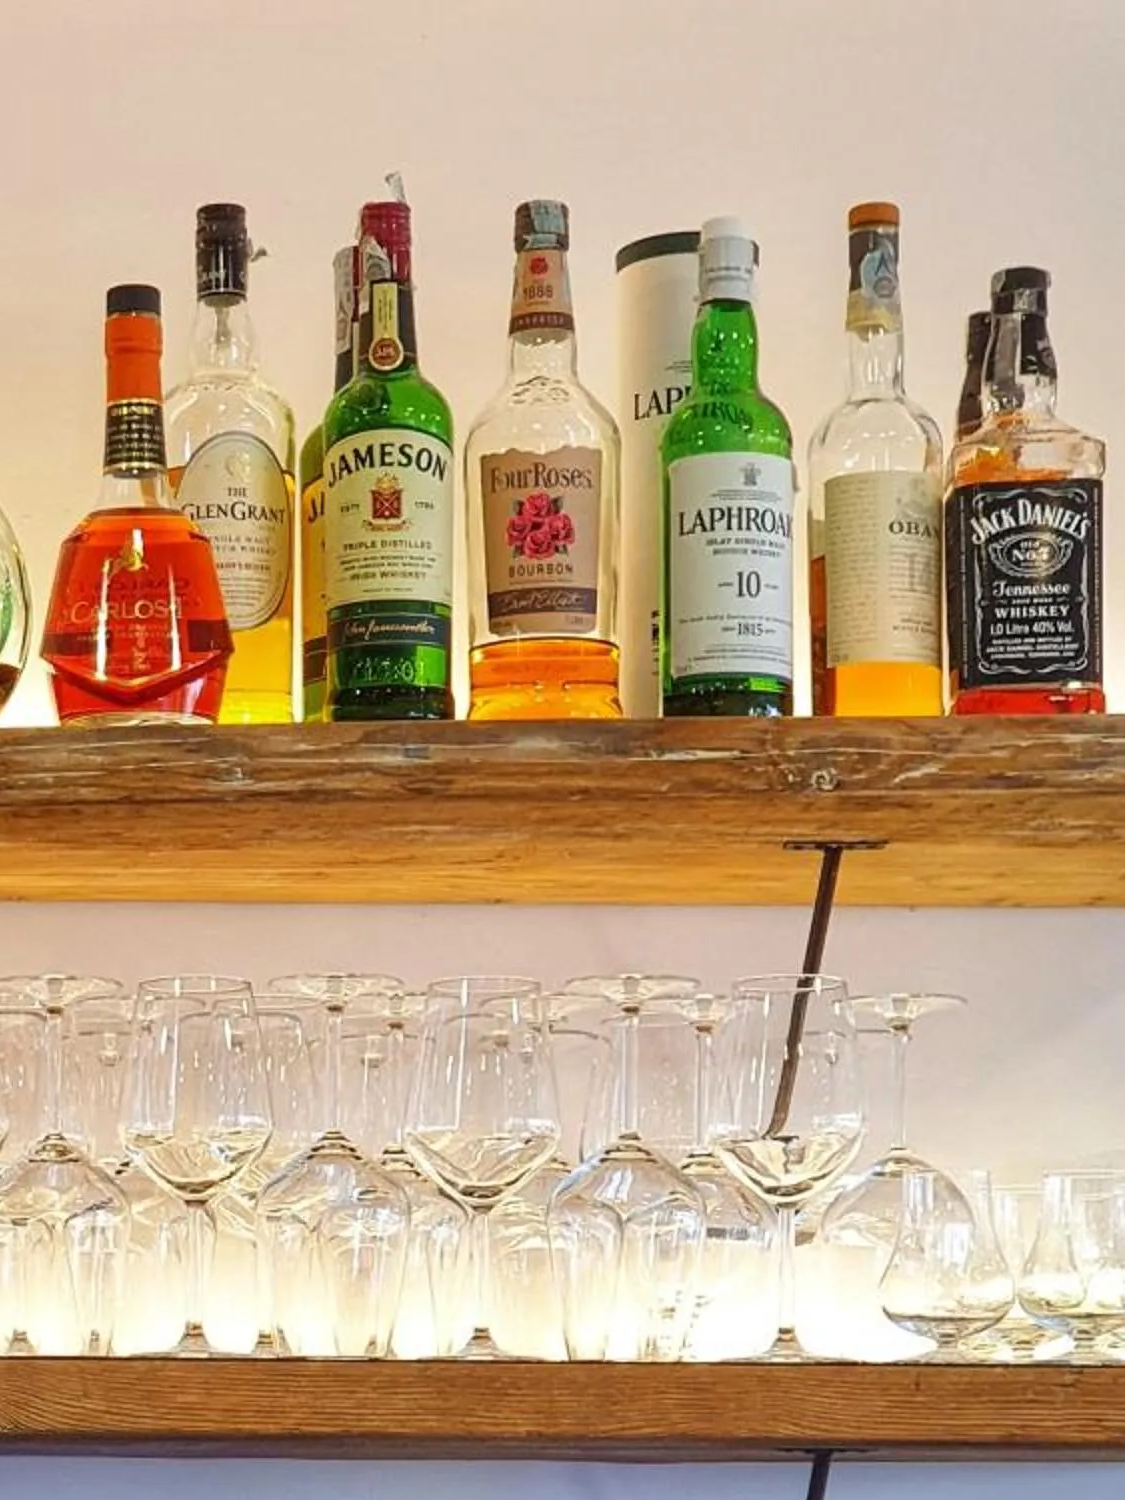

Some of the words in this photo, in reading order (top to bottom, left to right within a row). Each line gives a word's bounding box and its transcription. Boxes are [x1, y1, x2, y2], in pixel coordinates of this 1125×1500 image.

[328, 442, 447, 488] JAMESON
[490, 467, 533, 493] Four
[533, 462, 595, 489] Roses
[227, 487, 248, 497] THE
[678, 506, 793, 539] LAPHROAI
[970, 507, 1017, 545] JACK
[1017, 498, 1092, 541] DANIEL'S
[508, 563, 574, 578] BOURBON
[737, 571, 761, 598] 10
[992, 580, 1071, 598] Tennessee
[995, 604, 1070, 618] WHISKEY
